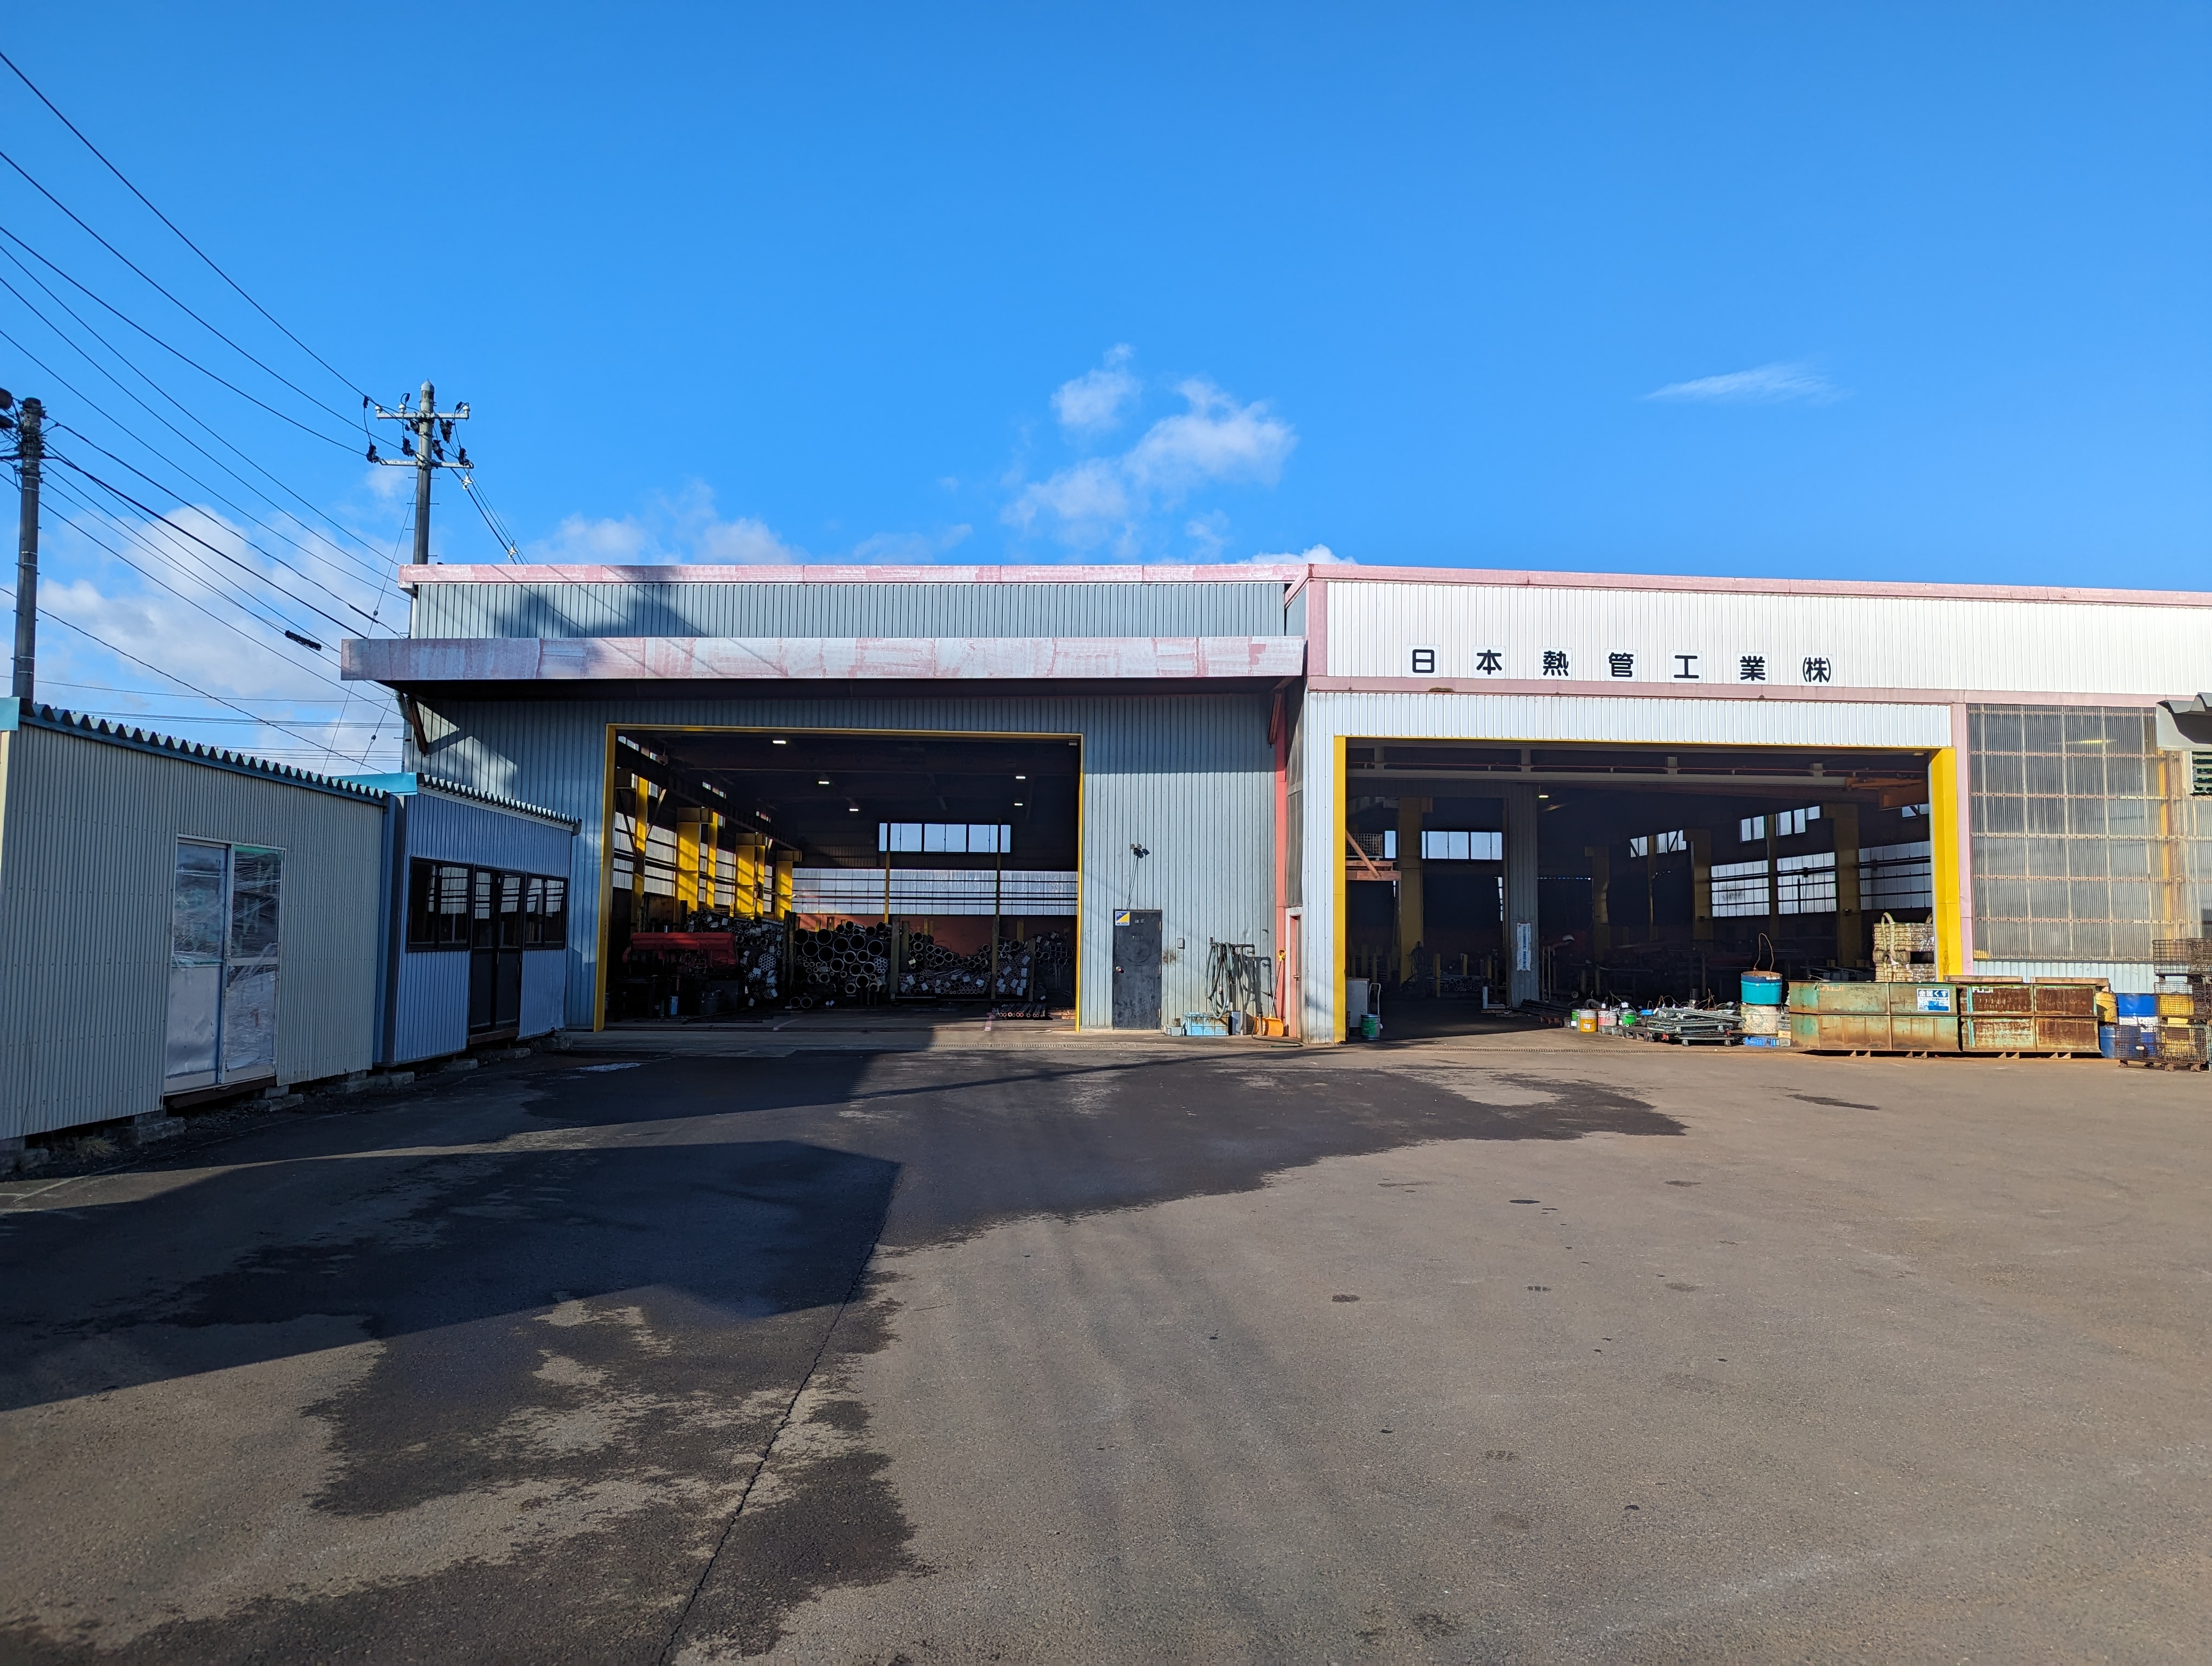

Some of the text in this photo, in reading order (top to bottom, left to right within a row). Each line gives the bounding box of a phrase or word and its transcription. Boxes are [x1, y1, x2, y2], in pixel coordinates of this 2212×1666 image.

[1412, 649, 1832, 683] 日本熱管工業(株)
